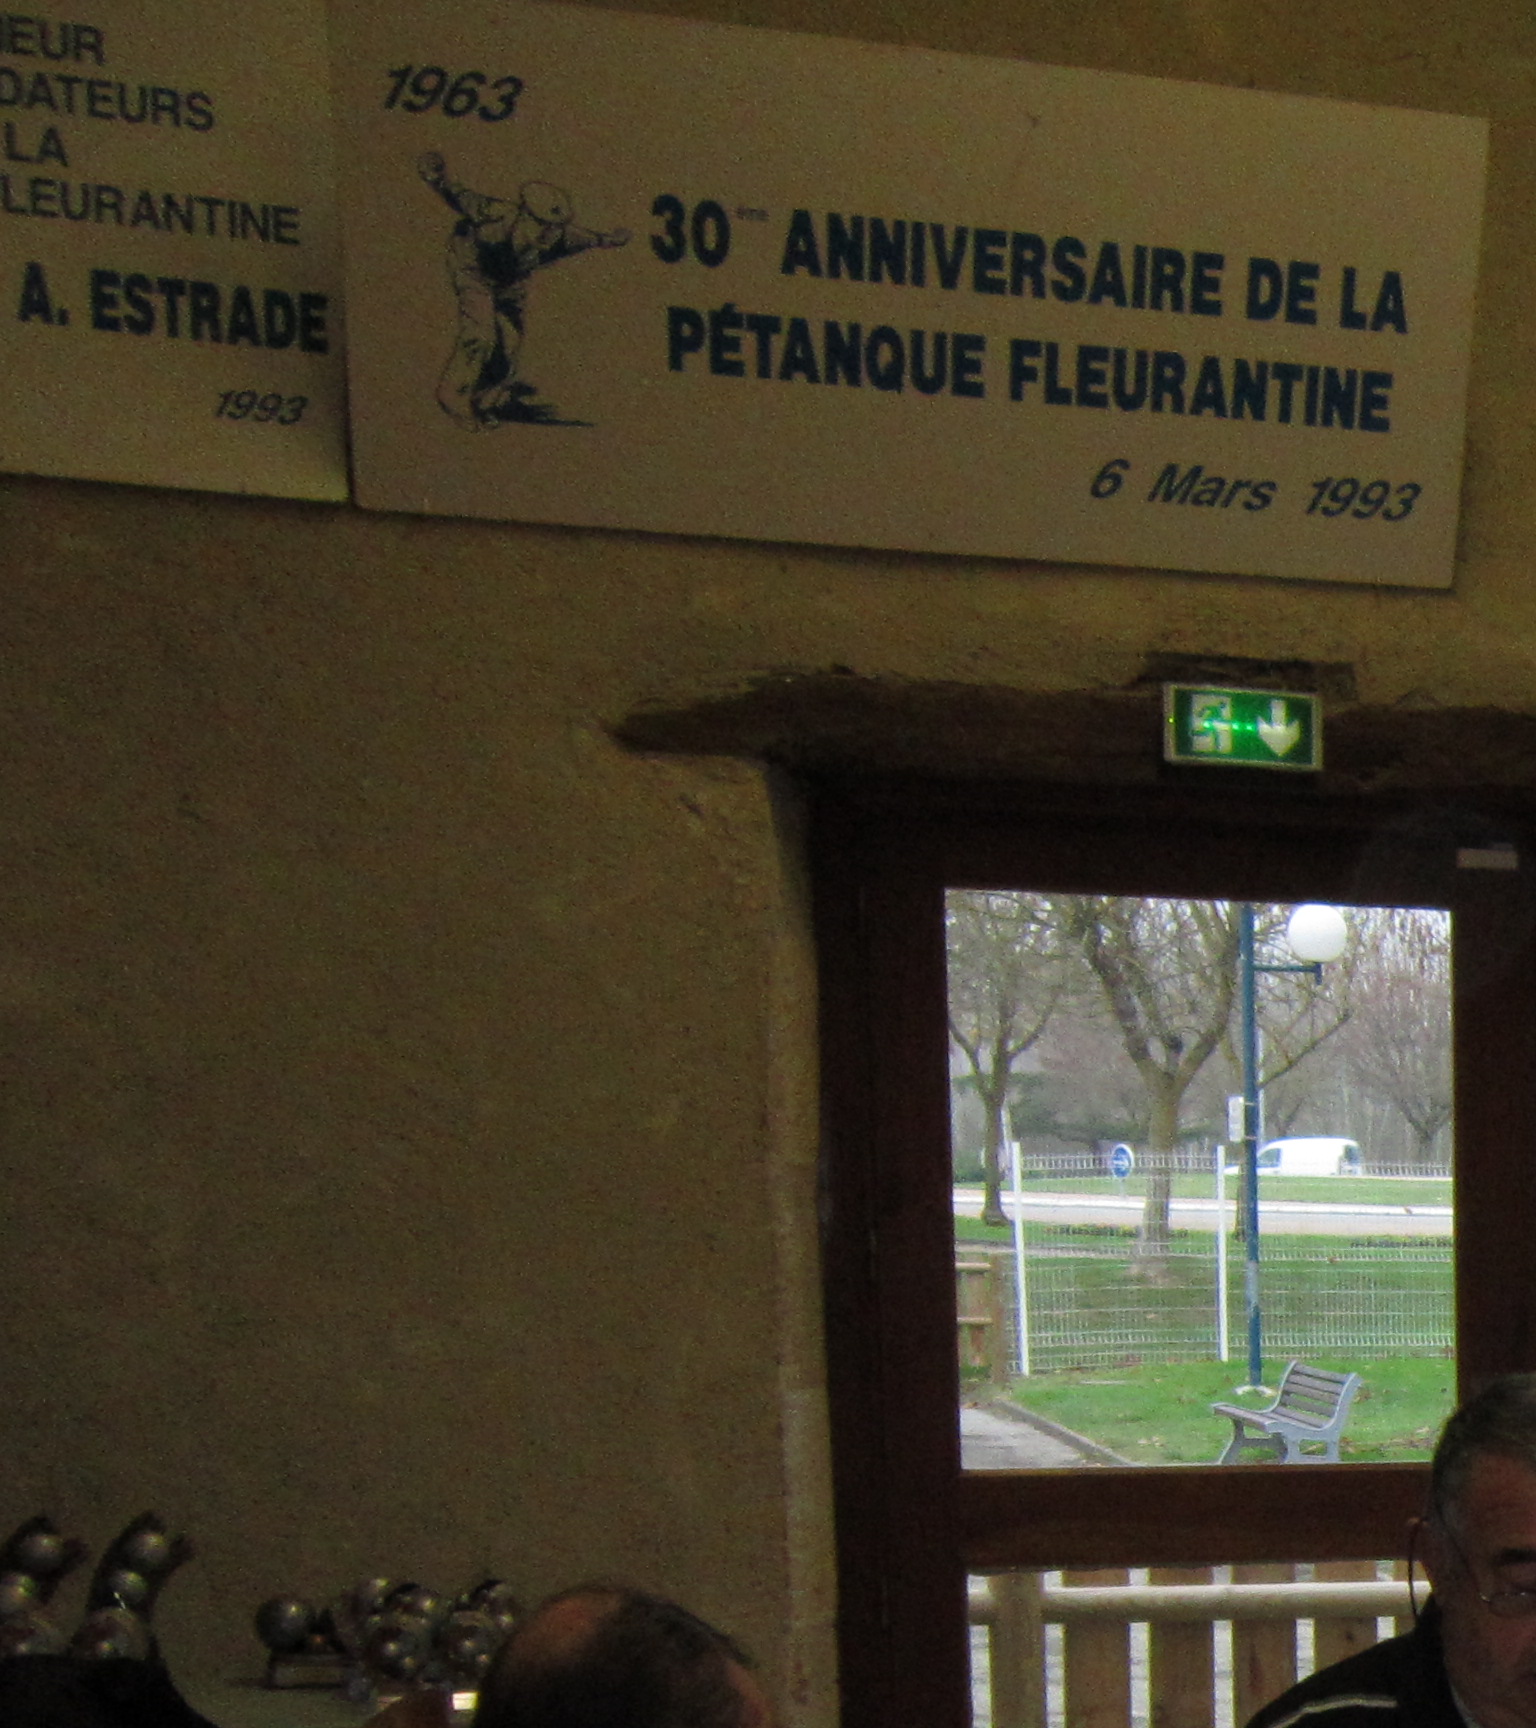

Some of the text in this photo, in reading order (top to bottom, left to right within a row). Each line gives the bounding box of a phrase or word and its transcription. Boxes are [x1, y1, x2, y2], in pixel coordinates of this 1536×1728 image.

[0, 14, 106, 65] EUR
[384, 65, 523, 122] 1963
[4, 121, 68, 167] LA
[781, 208, 1225, 316] ANNIVERSAIRE
[1247, 257, 1320, 325] DE
[1339, 265, 1408, 334] LA
[17, 261, 328, 354] A. ESTRADE
[667, 302, 1393, 433] PÉTANQUE FLEURANTINE
[215, 389, 308, 425] 1993
[1090, 459, 1422, 521] 6 Mars 1993
